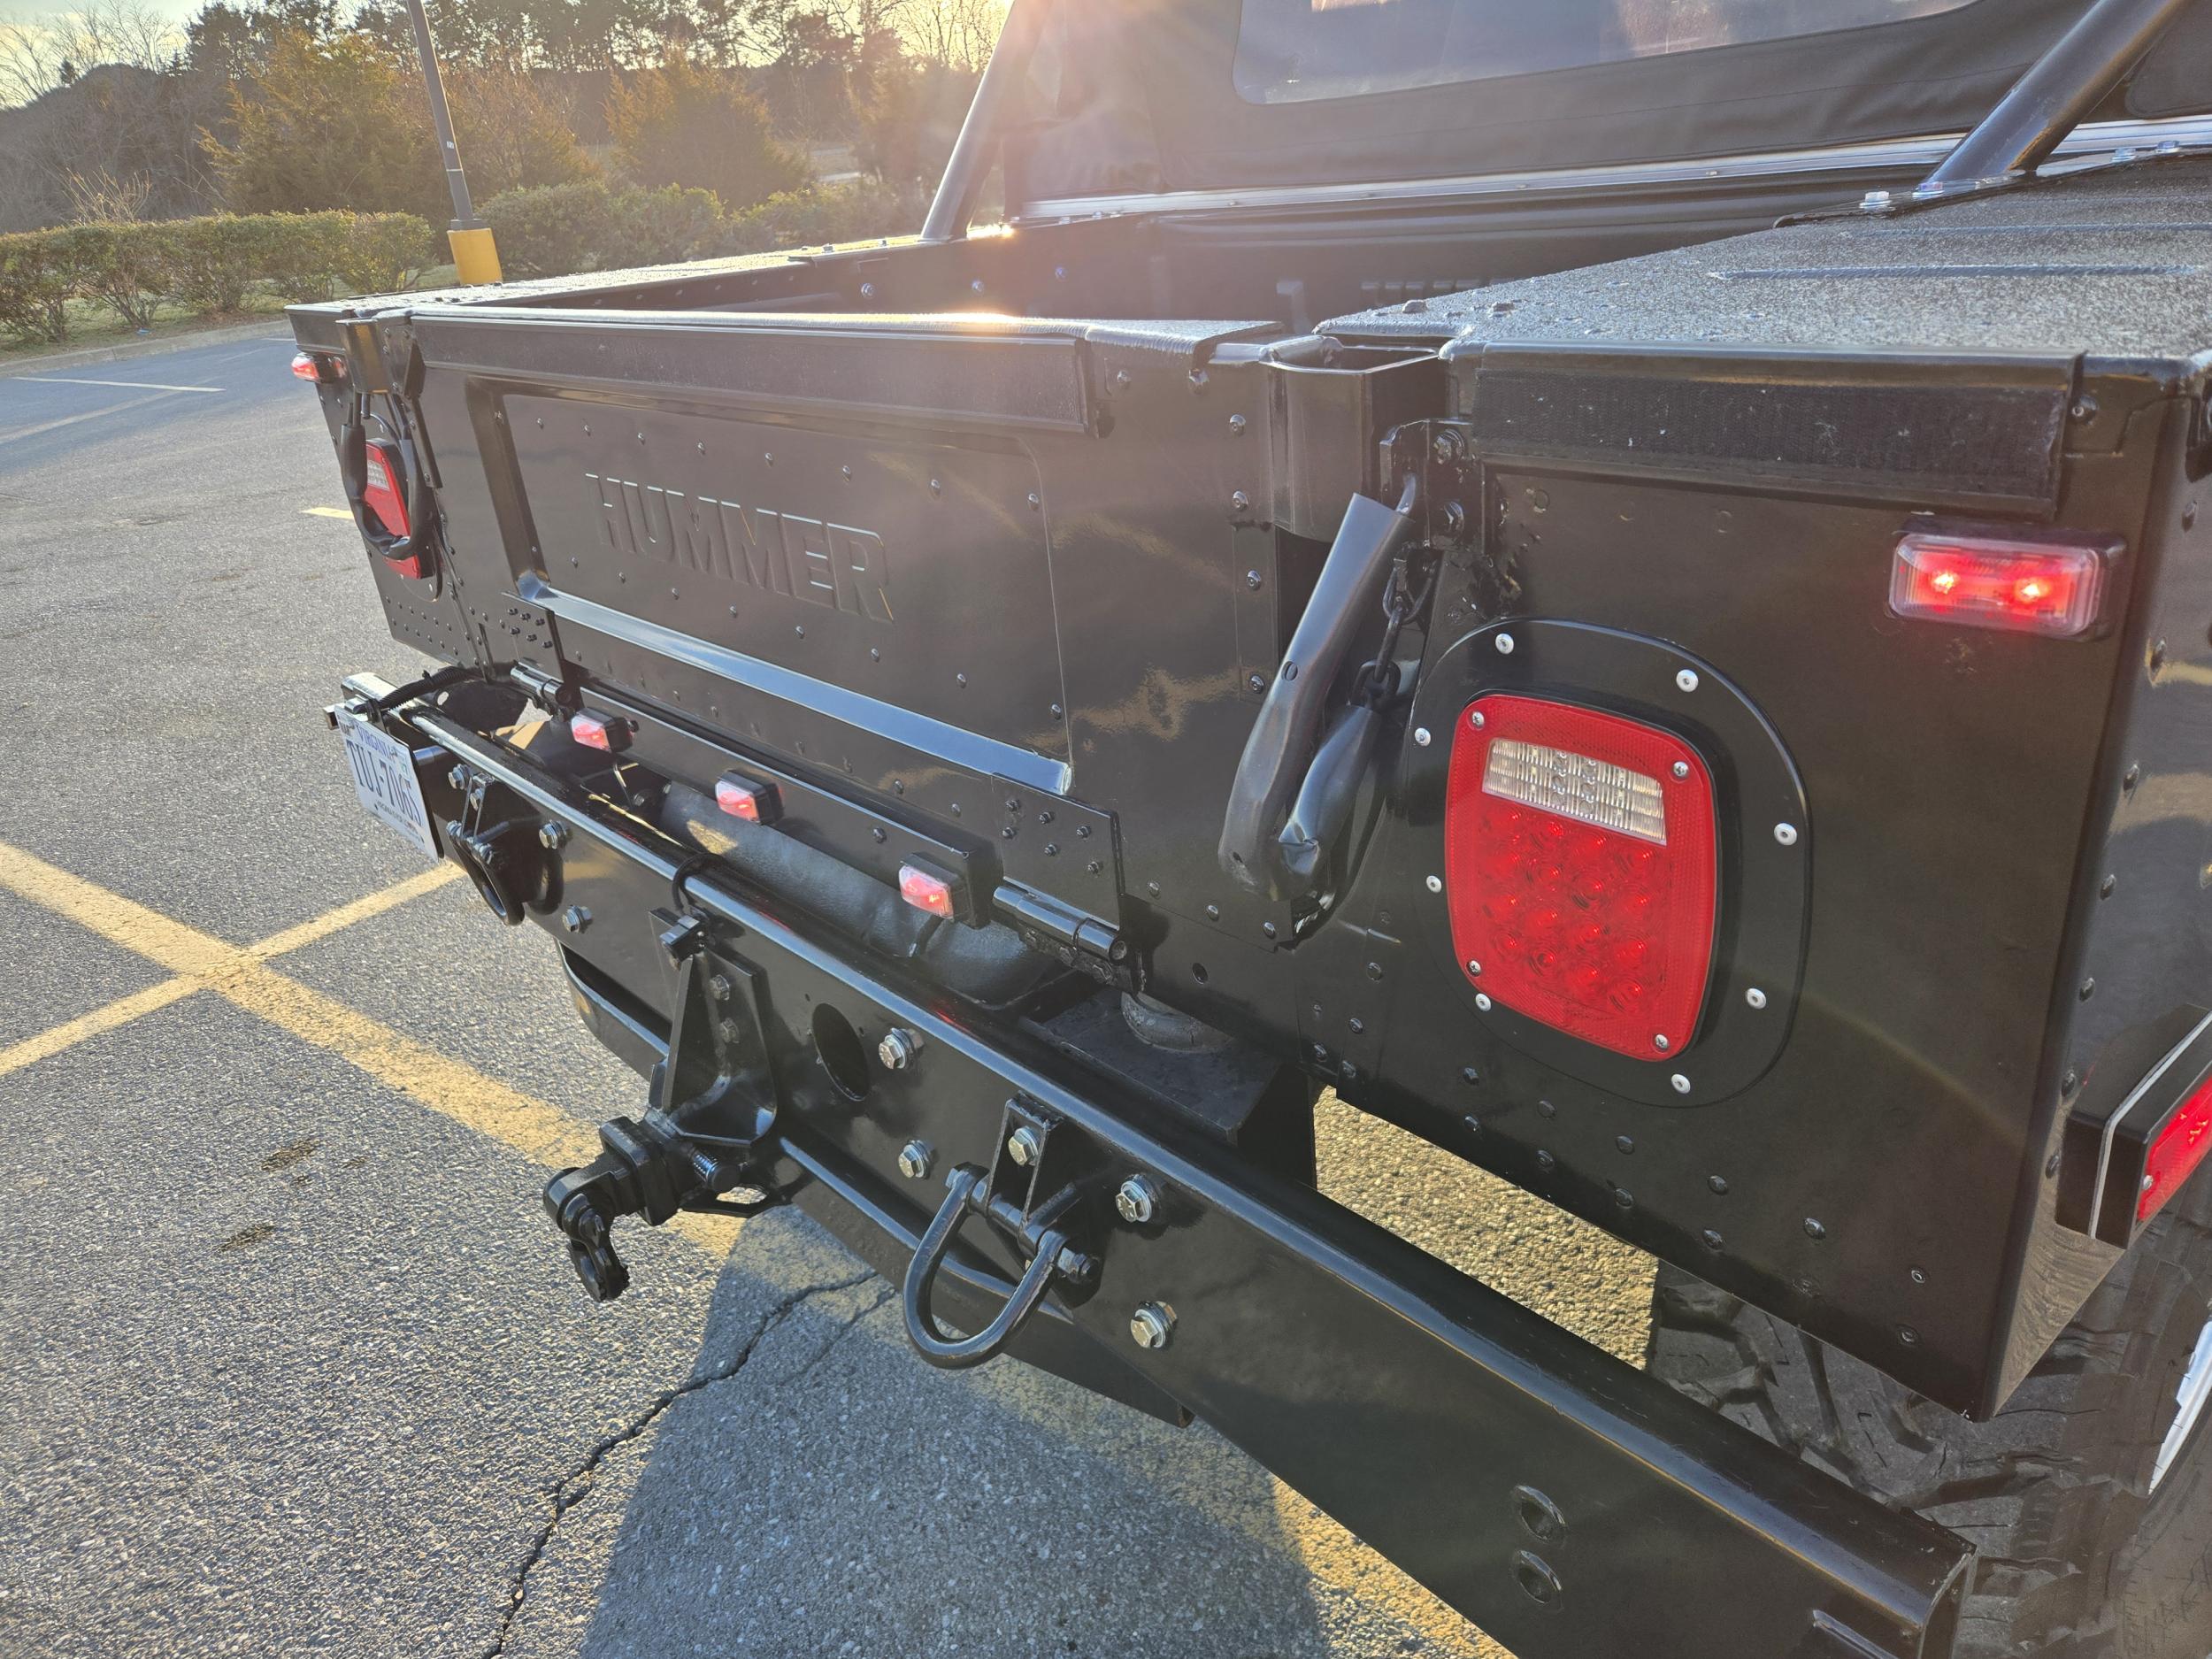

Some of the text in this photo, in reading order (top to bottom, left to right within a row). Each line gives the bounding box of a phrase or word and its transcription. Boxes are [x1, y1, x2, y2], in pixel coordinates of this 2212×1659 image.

[585, 472, 894, 624] HUMMER
[345, 737, 423, 827] TUJ-7065
[355, 722, 396, 763] VIRGINIA
